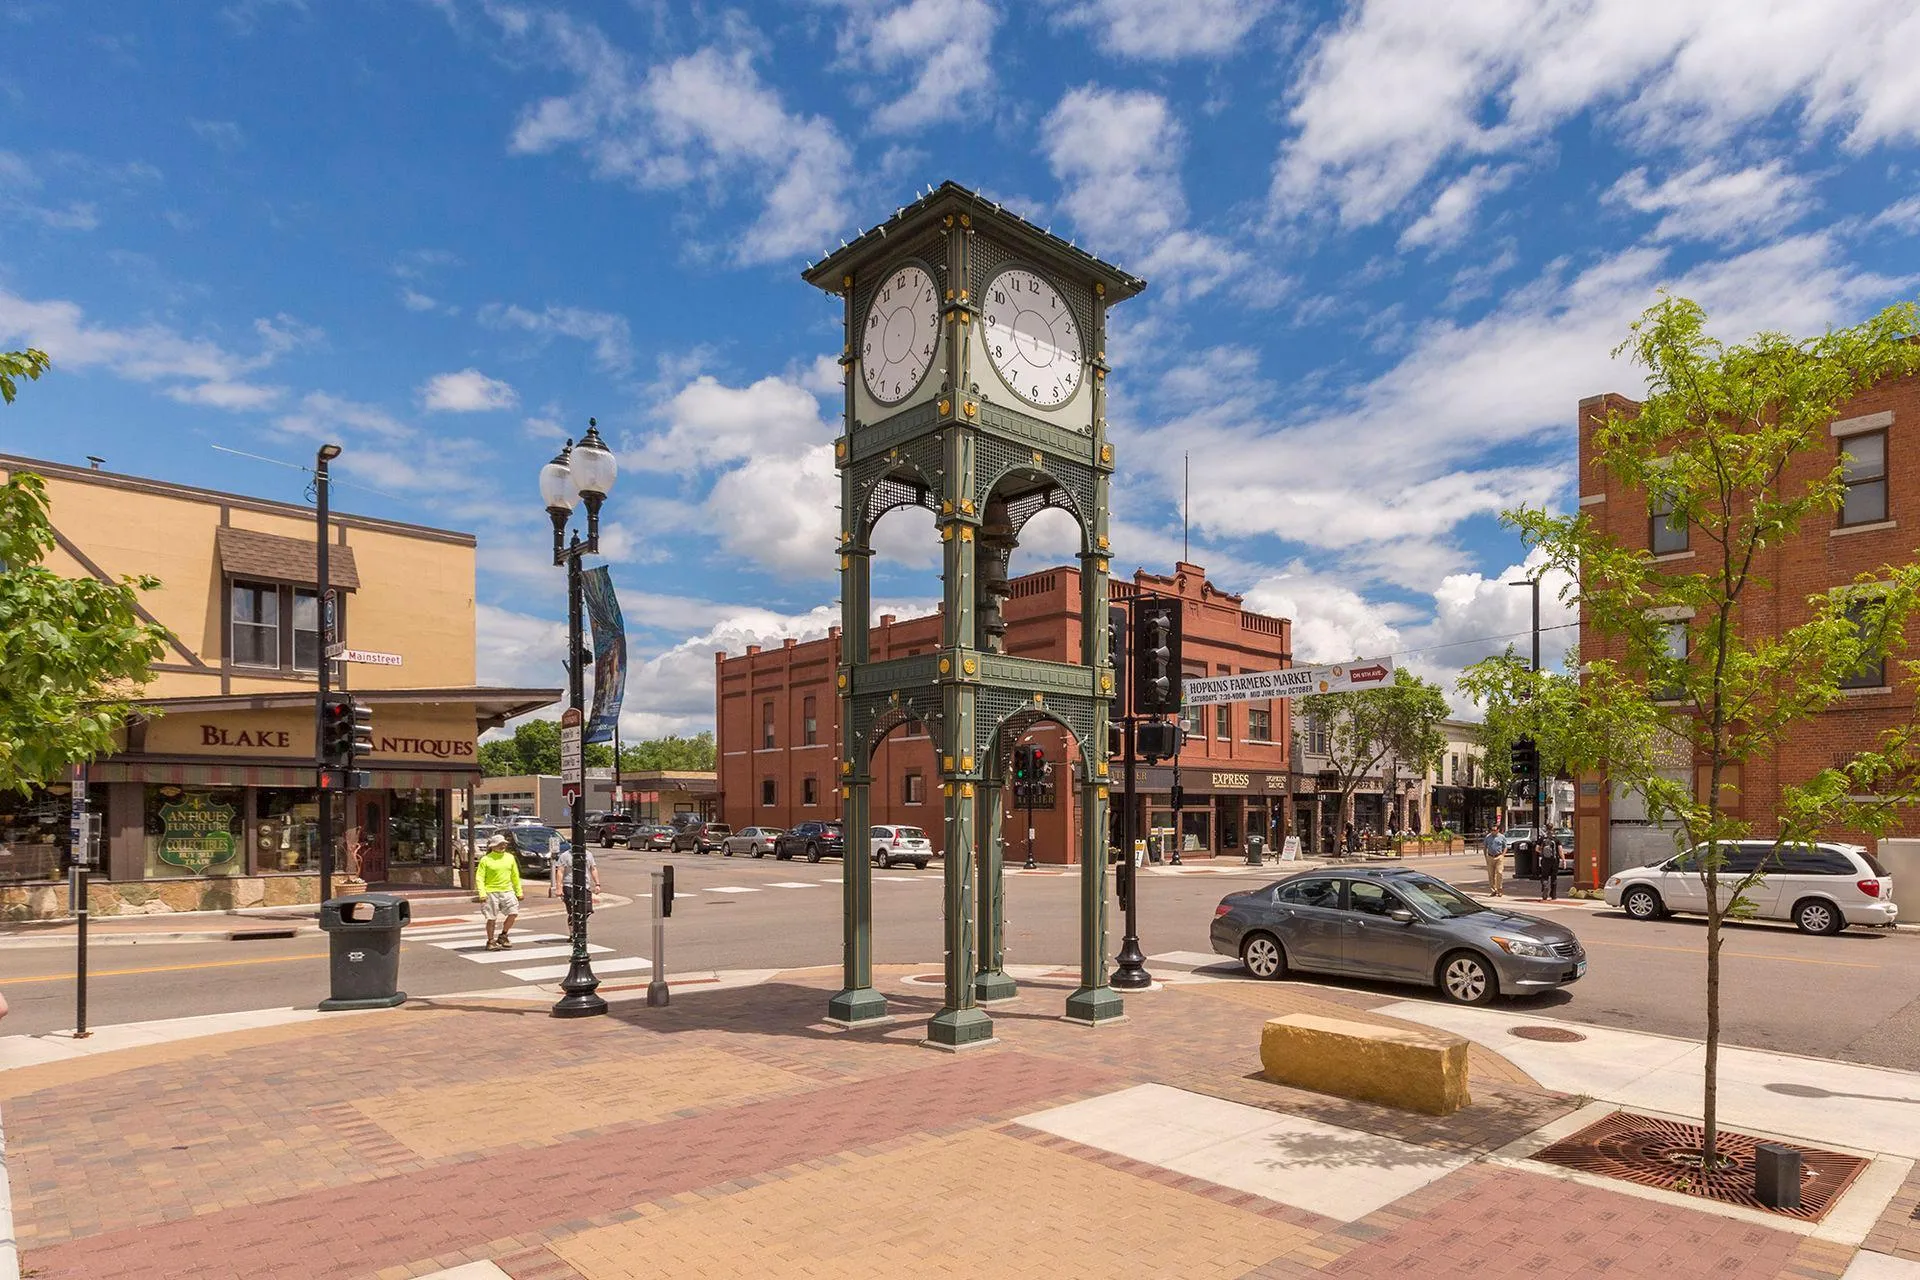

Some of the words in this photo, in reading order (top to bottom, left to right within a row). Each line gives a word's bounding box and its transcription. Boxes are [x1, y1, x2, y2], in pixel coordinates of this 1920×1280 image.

[896, 275, 906, 290] 12
[913, 274, 919, 288] 1
[1011, 278, 1021, 292] 11
[1028, 279, 1040, 295] 12
[882, 288, 891, 303] 11
[925, 289, 932, 302] 2
[994, 290, 1005, 305] 10
[1051, 297, 1056, 309] 1
[870, 314, 879, 329] 10
[929, 314, 936, 327] 3
[988, 315, 996, 327] 9
[1065, 322, 1071, 334] 2
[865, 343, 872, 356] 9
[923, 344, 930, 356] 4
[995, 345, 1002, 358] 8
[1071, 350, 1078, 362] 3
[869, 368, 875, 380] 8
[910, 368, 917, 380] 5
[1011, 370, 1018, 382] 7
[1065, 373, 1072, 385] 4
[880, 380, 886, 392] 7
[895, 381, 901, 395] 6
[1032, 385, 1039, 398] 6
[1053, 386, 1059, 398] 5
[348, 651, 400, 665] Mainstreet
[1190, 680, 1228, 694] HOPKINS
[1229, 675, 1271, 690] FARMERS
[1272, 671, 1312, 687] MARKET
[1191, 694, 1217, 703] SATURDAYS
[1250, 690, 1260, 698] MID
[1261, 689, 1275, 698] JUNE
[1275, 688, 1287, 696] thru
[1287, 685, 1313, 695] OCTOBER
[1212, 773, 1250, 786] EXPRESS
[168, 810, 229, 824] ANTIQUES
[167, 821, 229, 832] FURNITURE
[166, 839, 229, 851] COLLECTIBLES
[184, 858, 212, 866] TRADE
